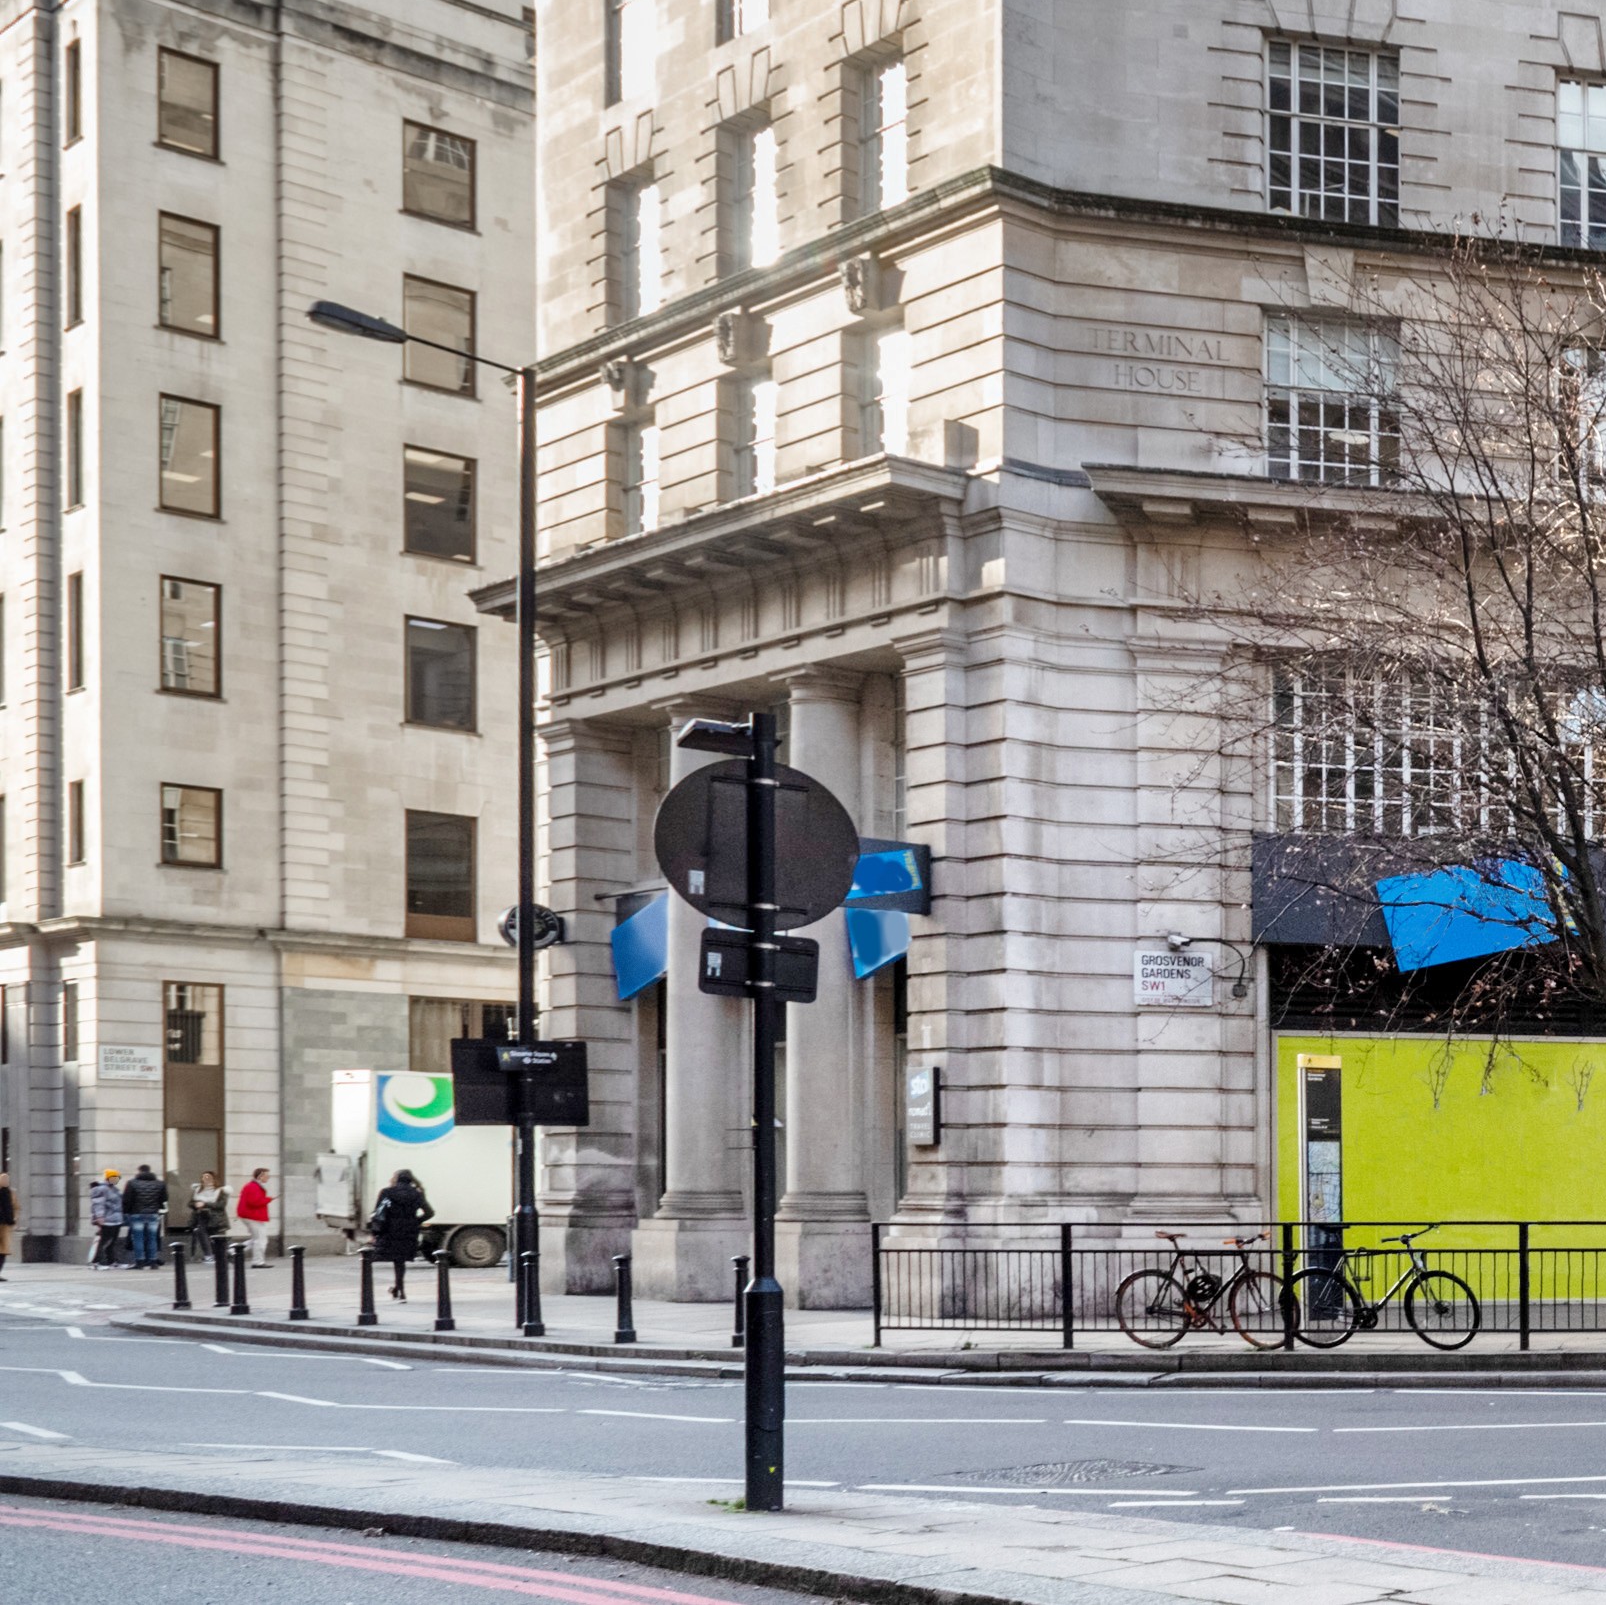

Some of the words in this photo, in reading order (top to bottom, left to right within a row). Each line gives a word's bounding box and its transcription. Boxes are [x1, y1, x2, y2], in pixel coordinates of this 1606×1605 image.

[1088, 327, 1231, 362] TERMINAL
[1114, 364, 1202, 393] HOUSE
[1141, 955, 1205, 967] GROSVENOR
[1141, 967, 1192, 979] GARDENS
[1141, 980, 1166, 991] SW1
[103, 1047, 134, 1055] LOWER
